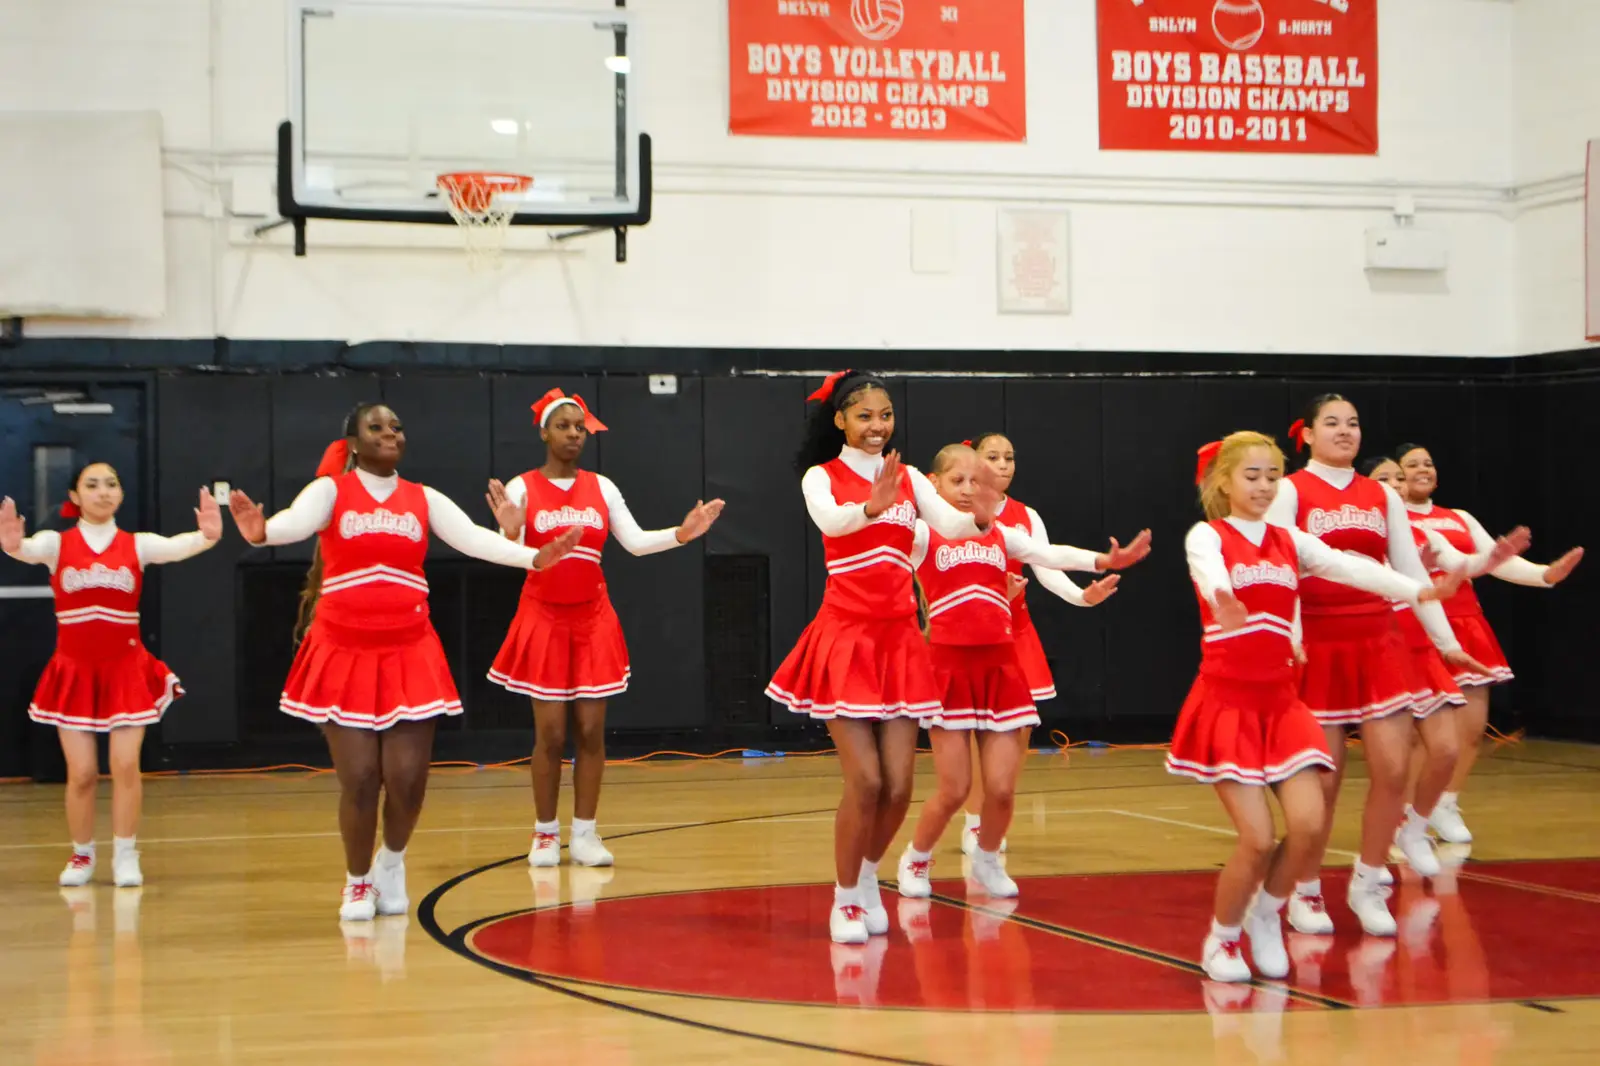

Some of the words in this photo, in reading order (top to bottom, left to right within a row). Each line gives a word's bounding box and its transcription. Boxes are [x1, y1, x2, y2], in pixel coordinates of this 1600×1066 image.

[1149, 16, 1197, 33] BKLYN
[747, 43, 822, 75] BOYS
[830, 46, 1006, 82] VOLLEYBALL
[1111, 50, 1191, 82] BOYS
[1199, 53, 1365, 87] BASEBALL
[766, 78, 879, 104] DIVISION
[885, 83, 989, 107] CHAMPS
[1126, 84, 1241, 110] DIVISION
[1247, 87, 1350, 112] CHAMPS
[811, 105, 867, 128] 2012
[890, 107, 947, 130] 2013
[1169, 114, 1308, 142] 2010-2011
[339, 507, 424, 543] Cardinals
[534, 505, 604, 533] Cardinals
[1308, 504, 1387, 538] Cardinals
[935, 540, 1006, 572] Cardinals
[61, 562, 136, 594] Cardinals
[1231, 560, 1298, 591] Cardinals
